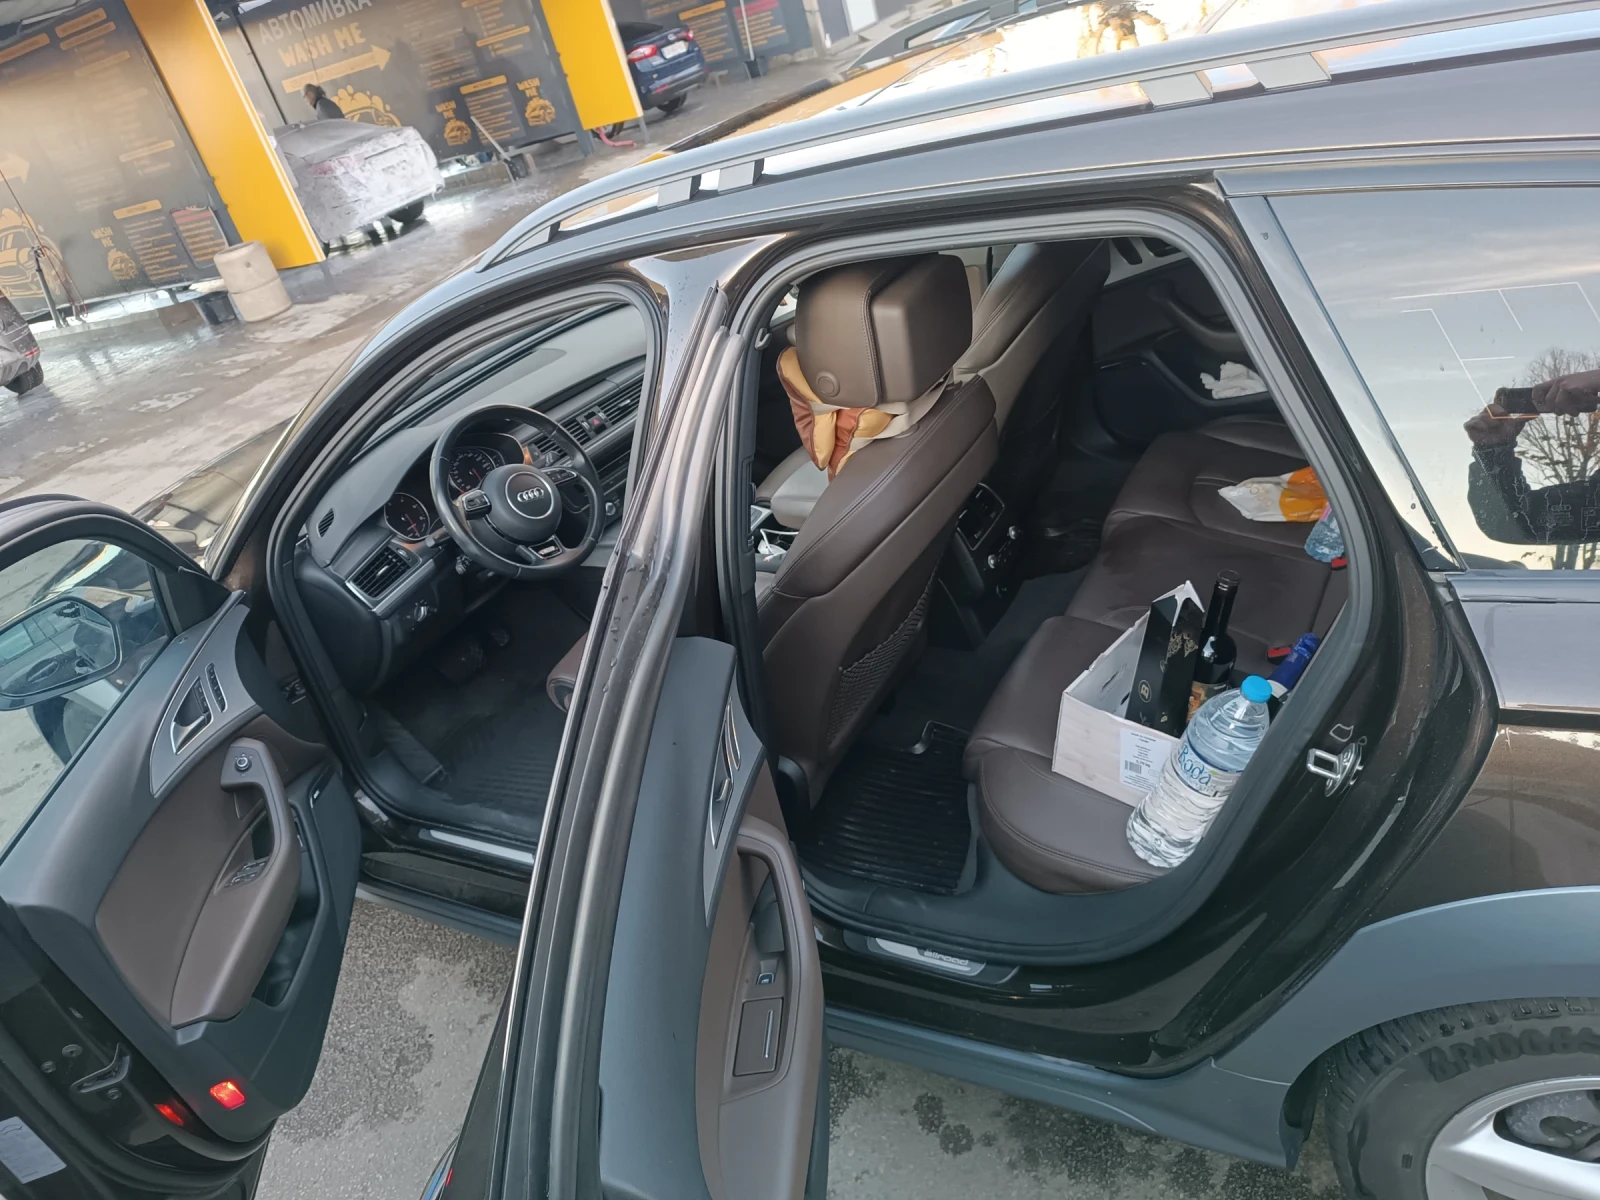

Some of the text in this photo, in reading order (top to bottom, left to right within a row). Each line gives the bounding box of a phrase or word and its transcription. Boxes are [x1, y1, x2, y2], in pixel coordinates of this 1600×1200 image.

[277, 21, 366, 68] WASH ME
[516, 77, 540, 91] WASH
[90, 226, 114, 239] WASH
[923, 949, 969, 966] allroad
